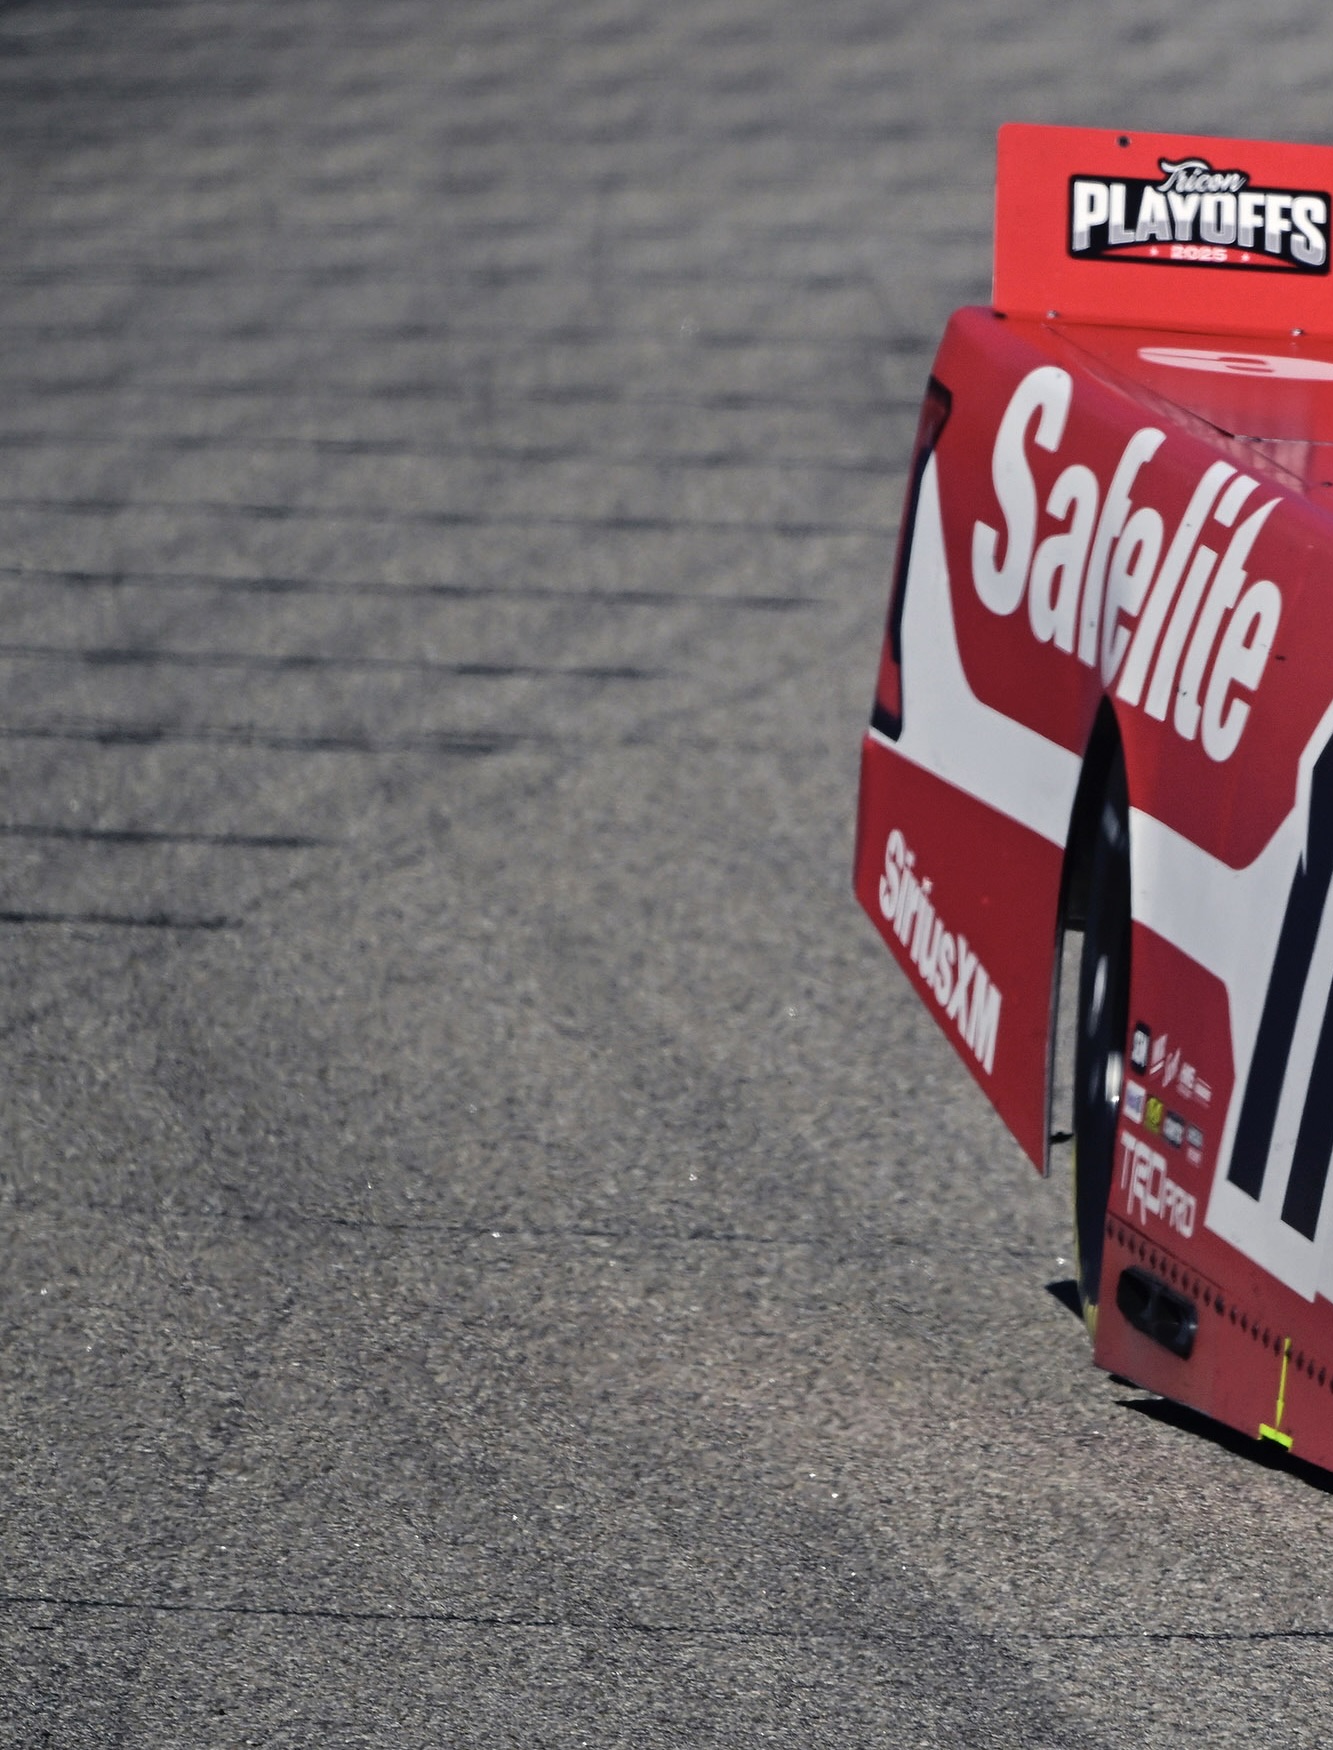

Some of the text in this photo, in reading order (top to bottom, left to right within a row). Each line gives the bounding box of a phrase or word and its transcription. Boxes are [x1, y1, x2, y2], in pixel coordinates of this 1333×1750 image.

[1157, 159, 1247, 193] Tricon
[1072, 179, 1328, 267] PLAYOFFS
[1170, 245, 1228, 263] 2025
[971, 365, 1284, 763] Safelite
[878, 828, 1002, 1077] SiriusXM
